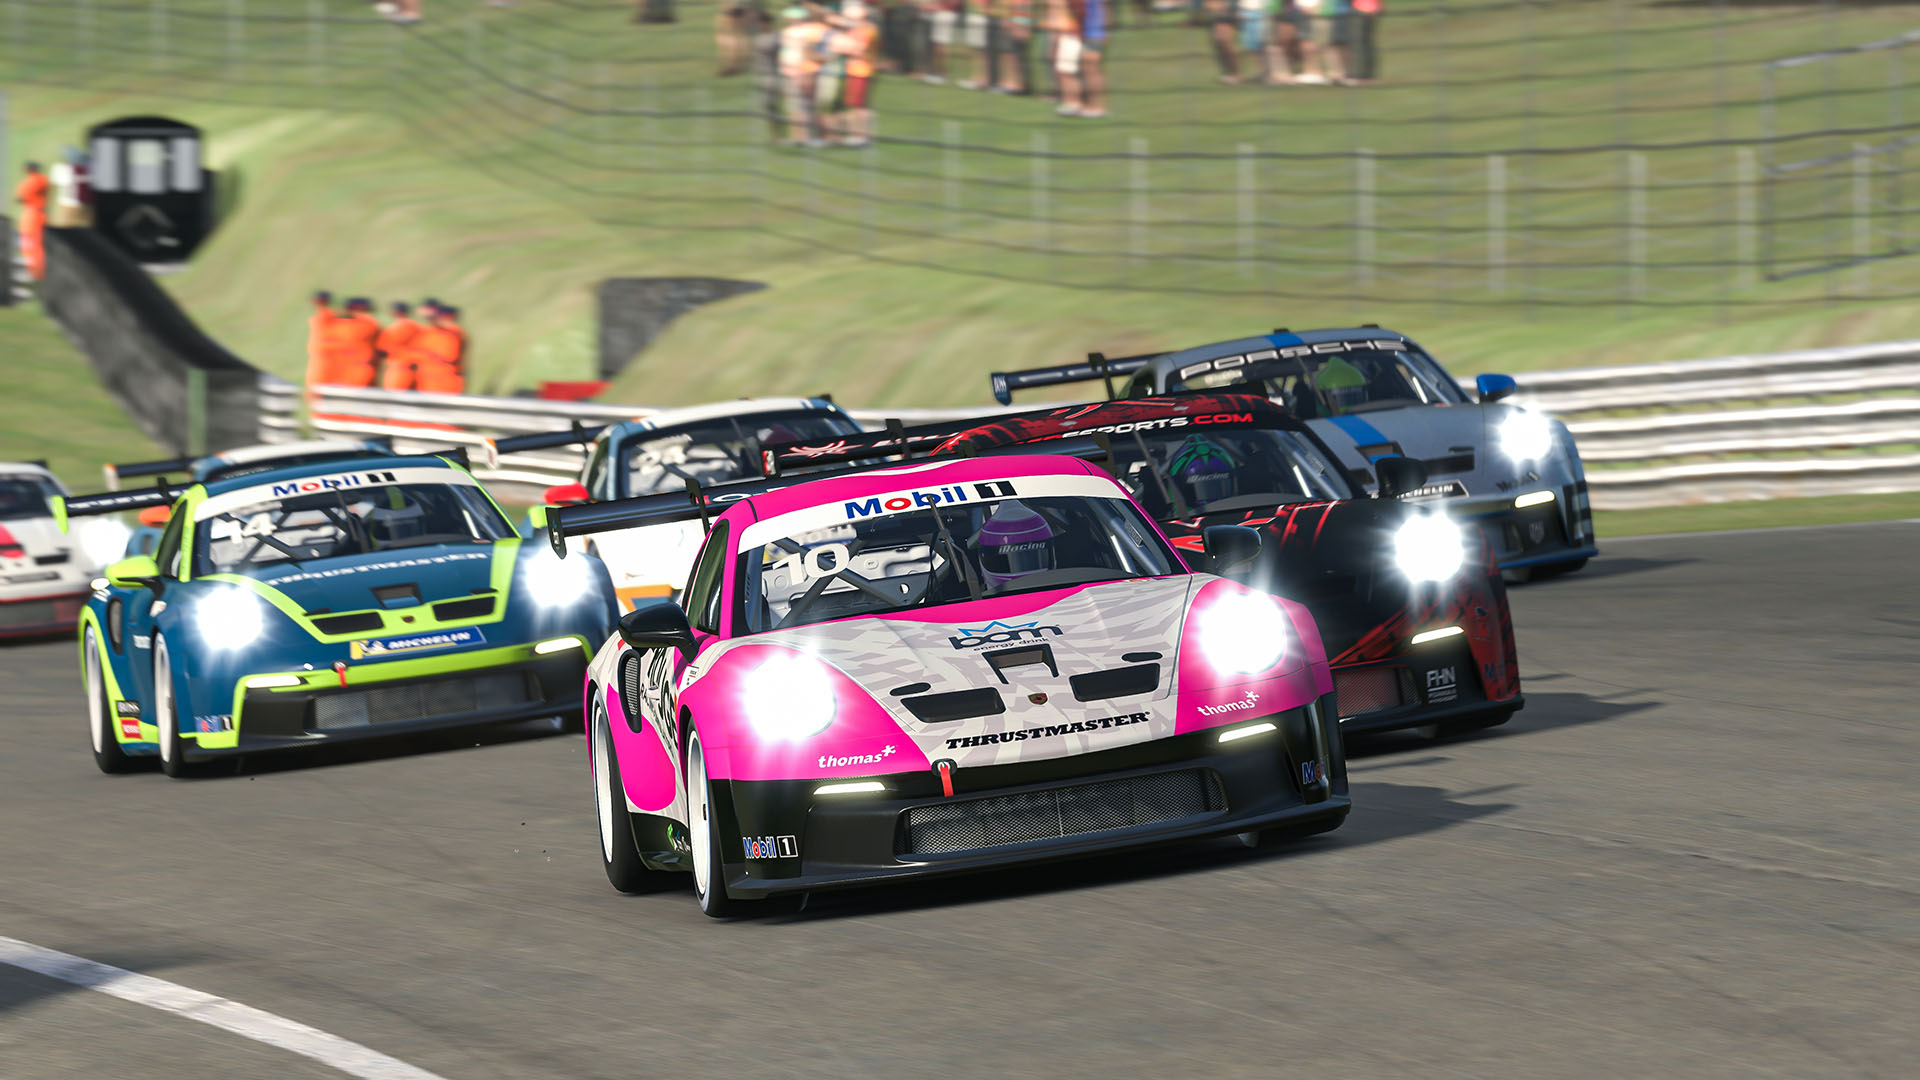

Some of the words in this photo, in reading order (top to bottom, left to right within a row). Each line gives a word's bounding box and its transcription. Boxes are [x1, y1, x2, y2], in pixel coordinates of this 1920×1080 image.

[1181, 340, 1407, 380] PORSCHE
[272, 475, 361, 497] Mobil
[845, 485, 968, 519] Mobil
[772, 543, 850, 586] 10
[973, 641, 1015, 651] energy
[1197, 699, 1256, 716] thomas
[946, 712, 1149, 749] THRUSTMASTER
[818, 752, 883, 768] thomas
[743, 836, 777, 858] Mobil
